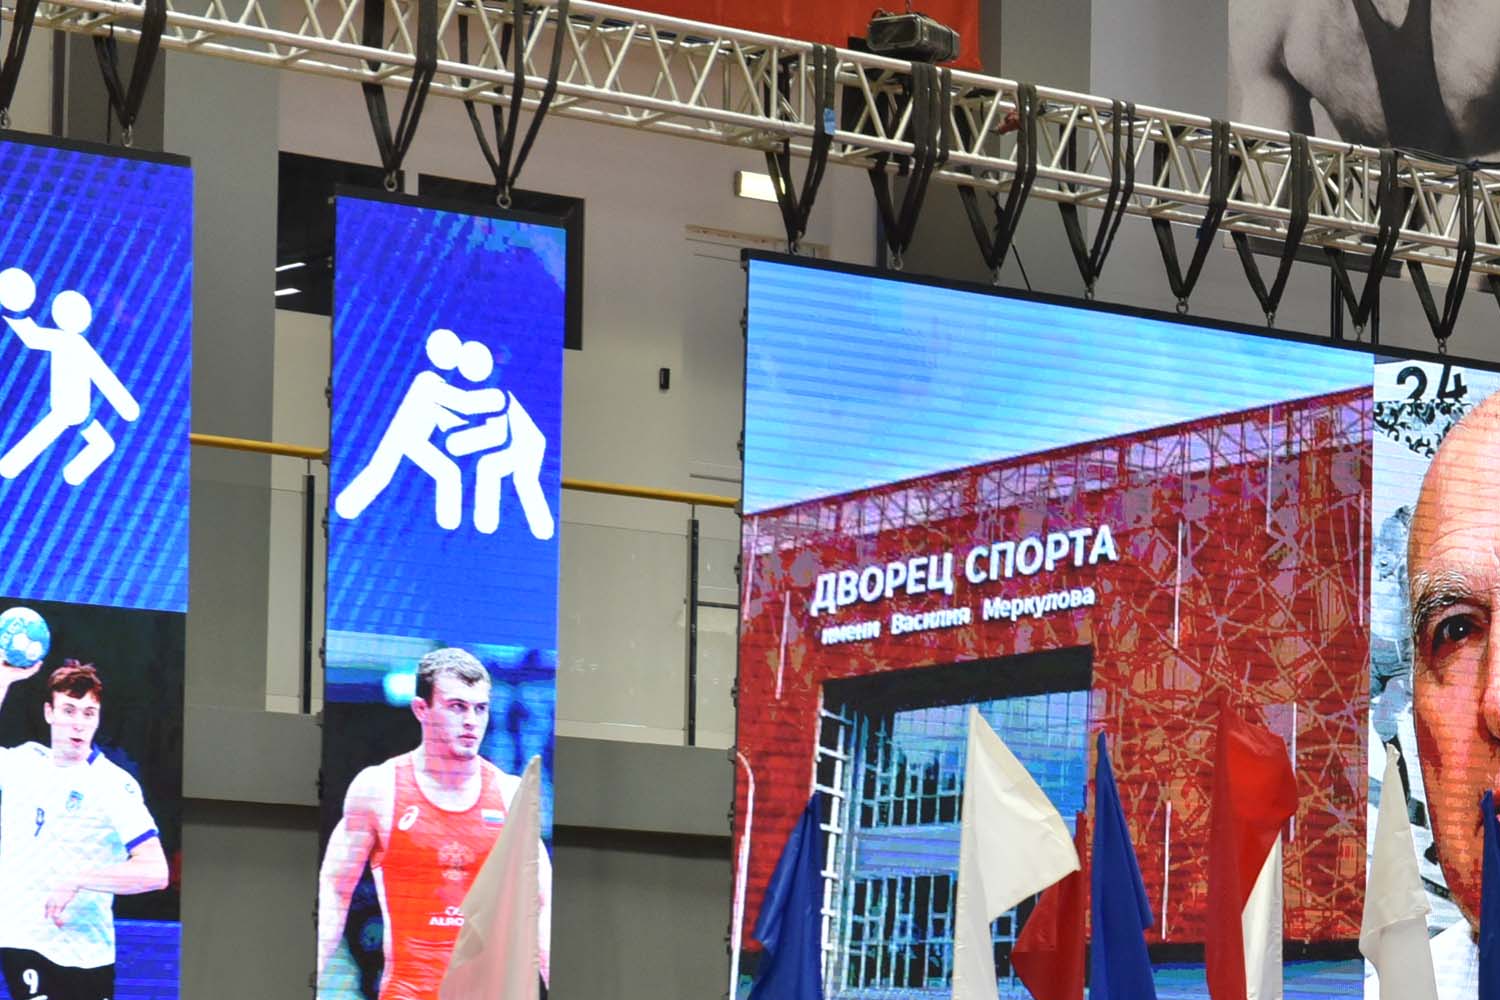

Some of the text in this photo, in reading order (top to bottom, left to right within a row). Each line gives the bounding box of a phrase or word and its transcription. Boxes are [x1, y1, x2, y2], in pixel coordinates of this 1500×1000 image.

[1396, 360, 1468, 401] 24
[810, 524, 1119, 617] ДВОРЕЦ СПОРТА
[821, 586, 1096, 645] имени Василия Меркулова
[429, 916, 465, 926] ALRO
[22, 968, 39, 994] 9
